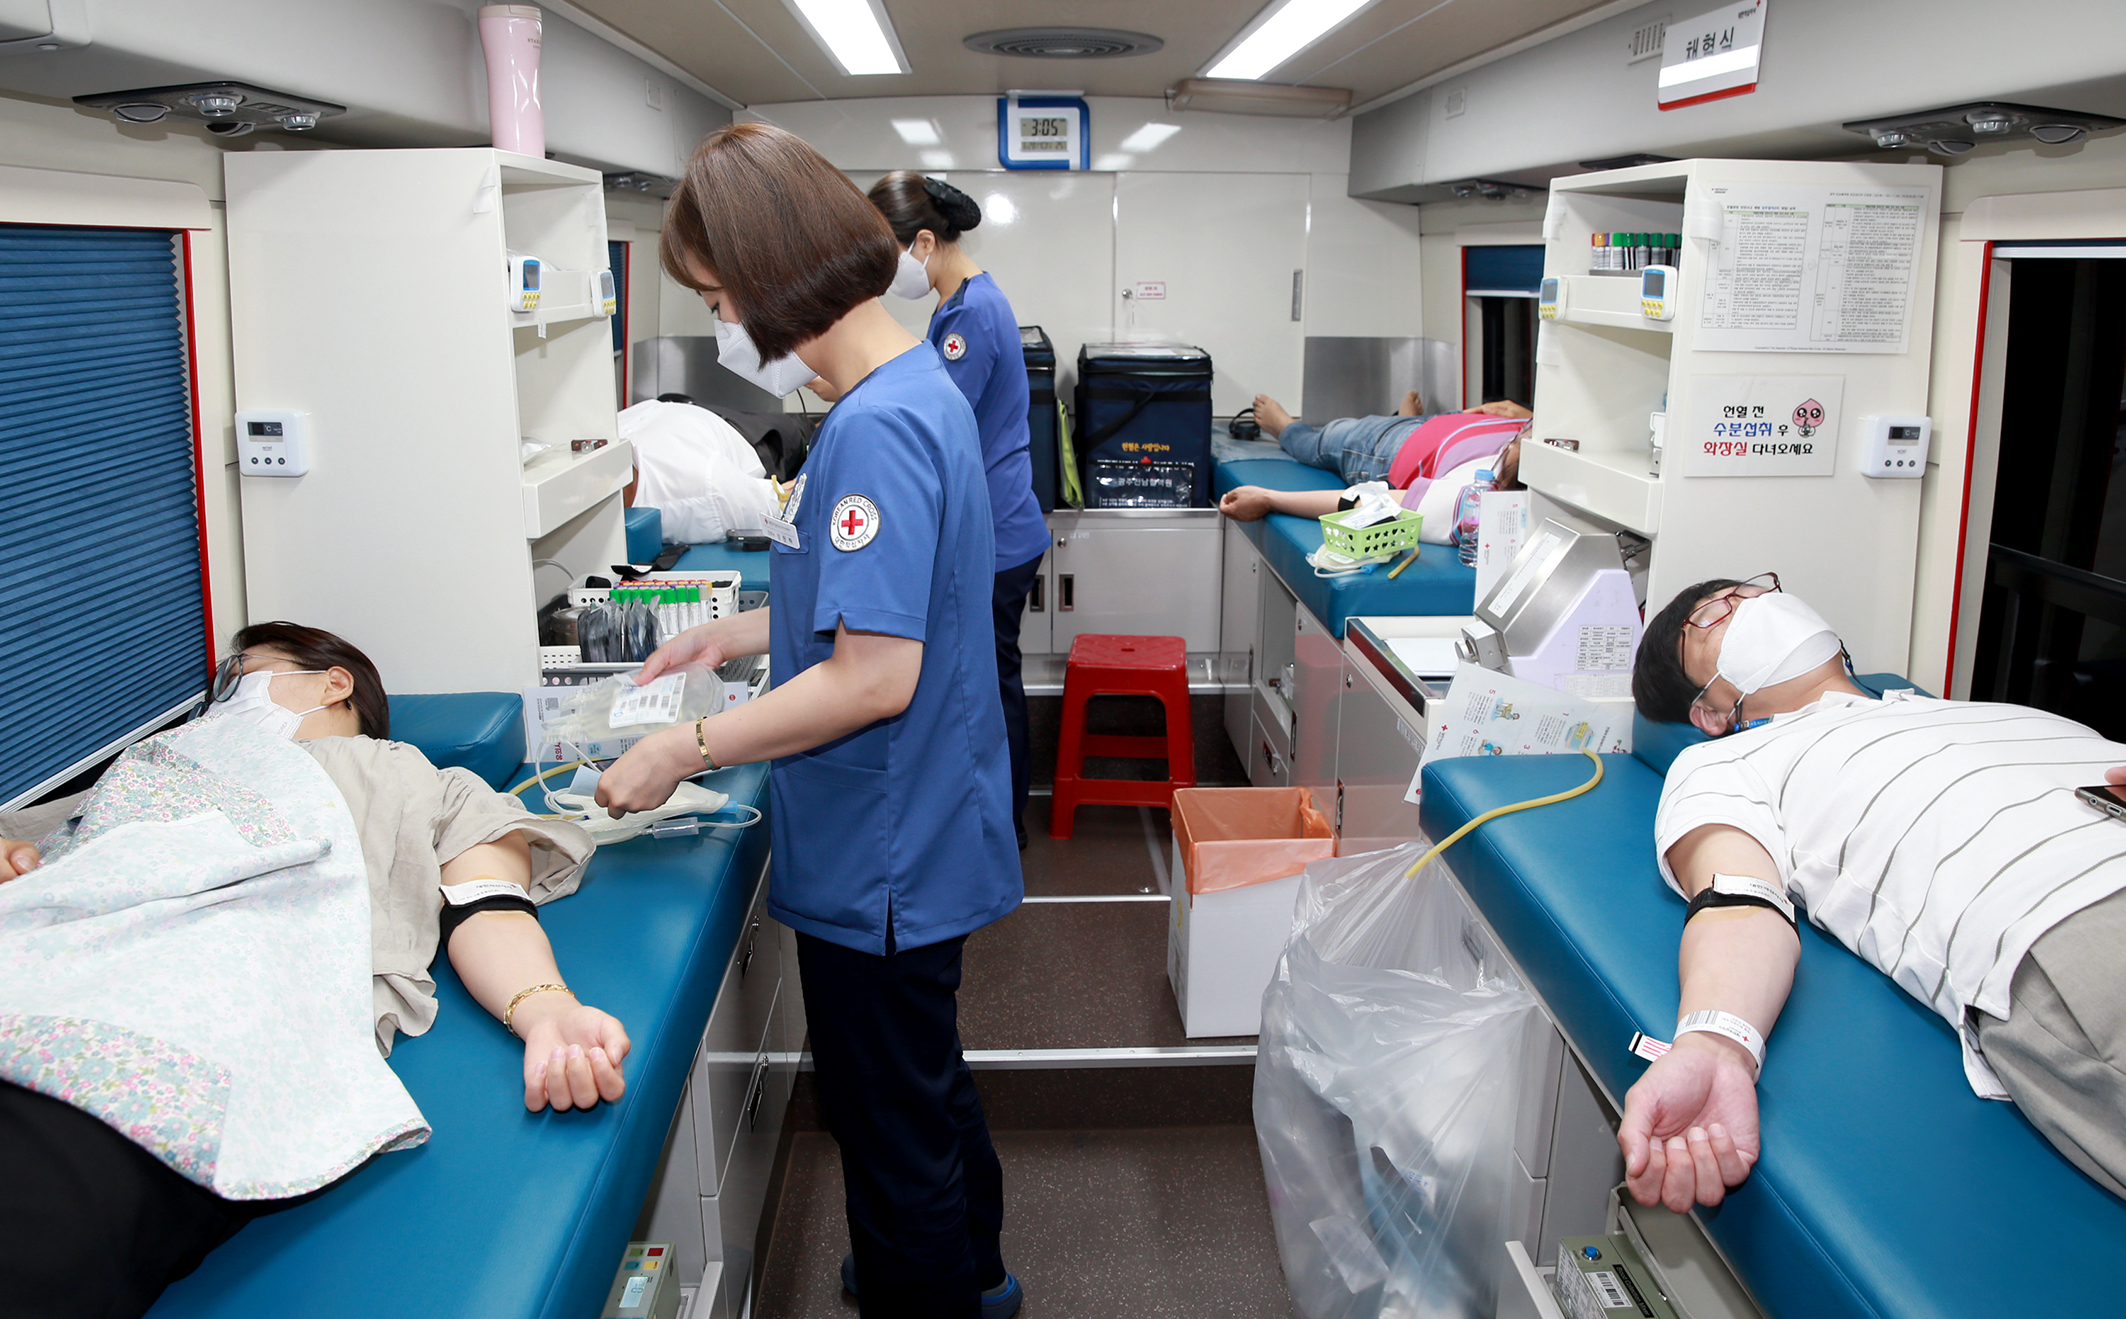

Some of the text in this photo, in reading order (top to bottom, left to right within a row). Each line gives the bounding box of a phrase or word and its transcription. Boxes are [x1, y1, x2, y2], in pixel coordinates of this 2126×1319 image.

[1031, 118, 1058, 137] 3:05
[1723, 405, 1765, 419] 헌혈 전
[1713, 422, 1773, 437] 수분섭취
[1703, 441, 1814, 457] 화장실 다녀오세요
[832, 496, 878, 526] KOREAN RED CROSS
[835, 533, 872, 549] 대한적십자사
